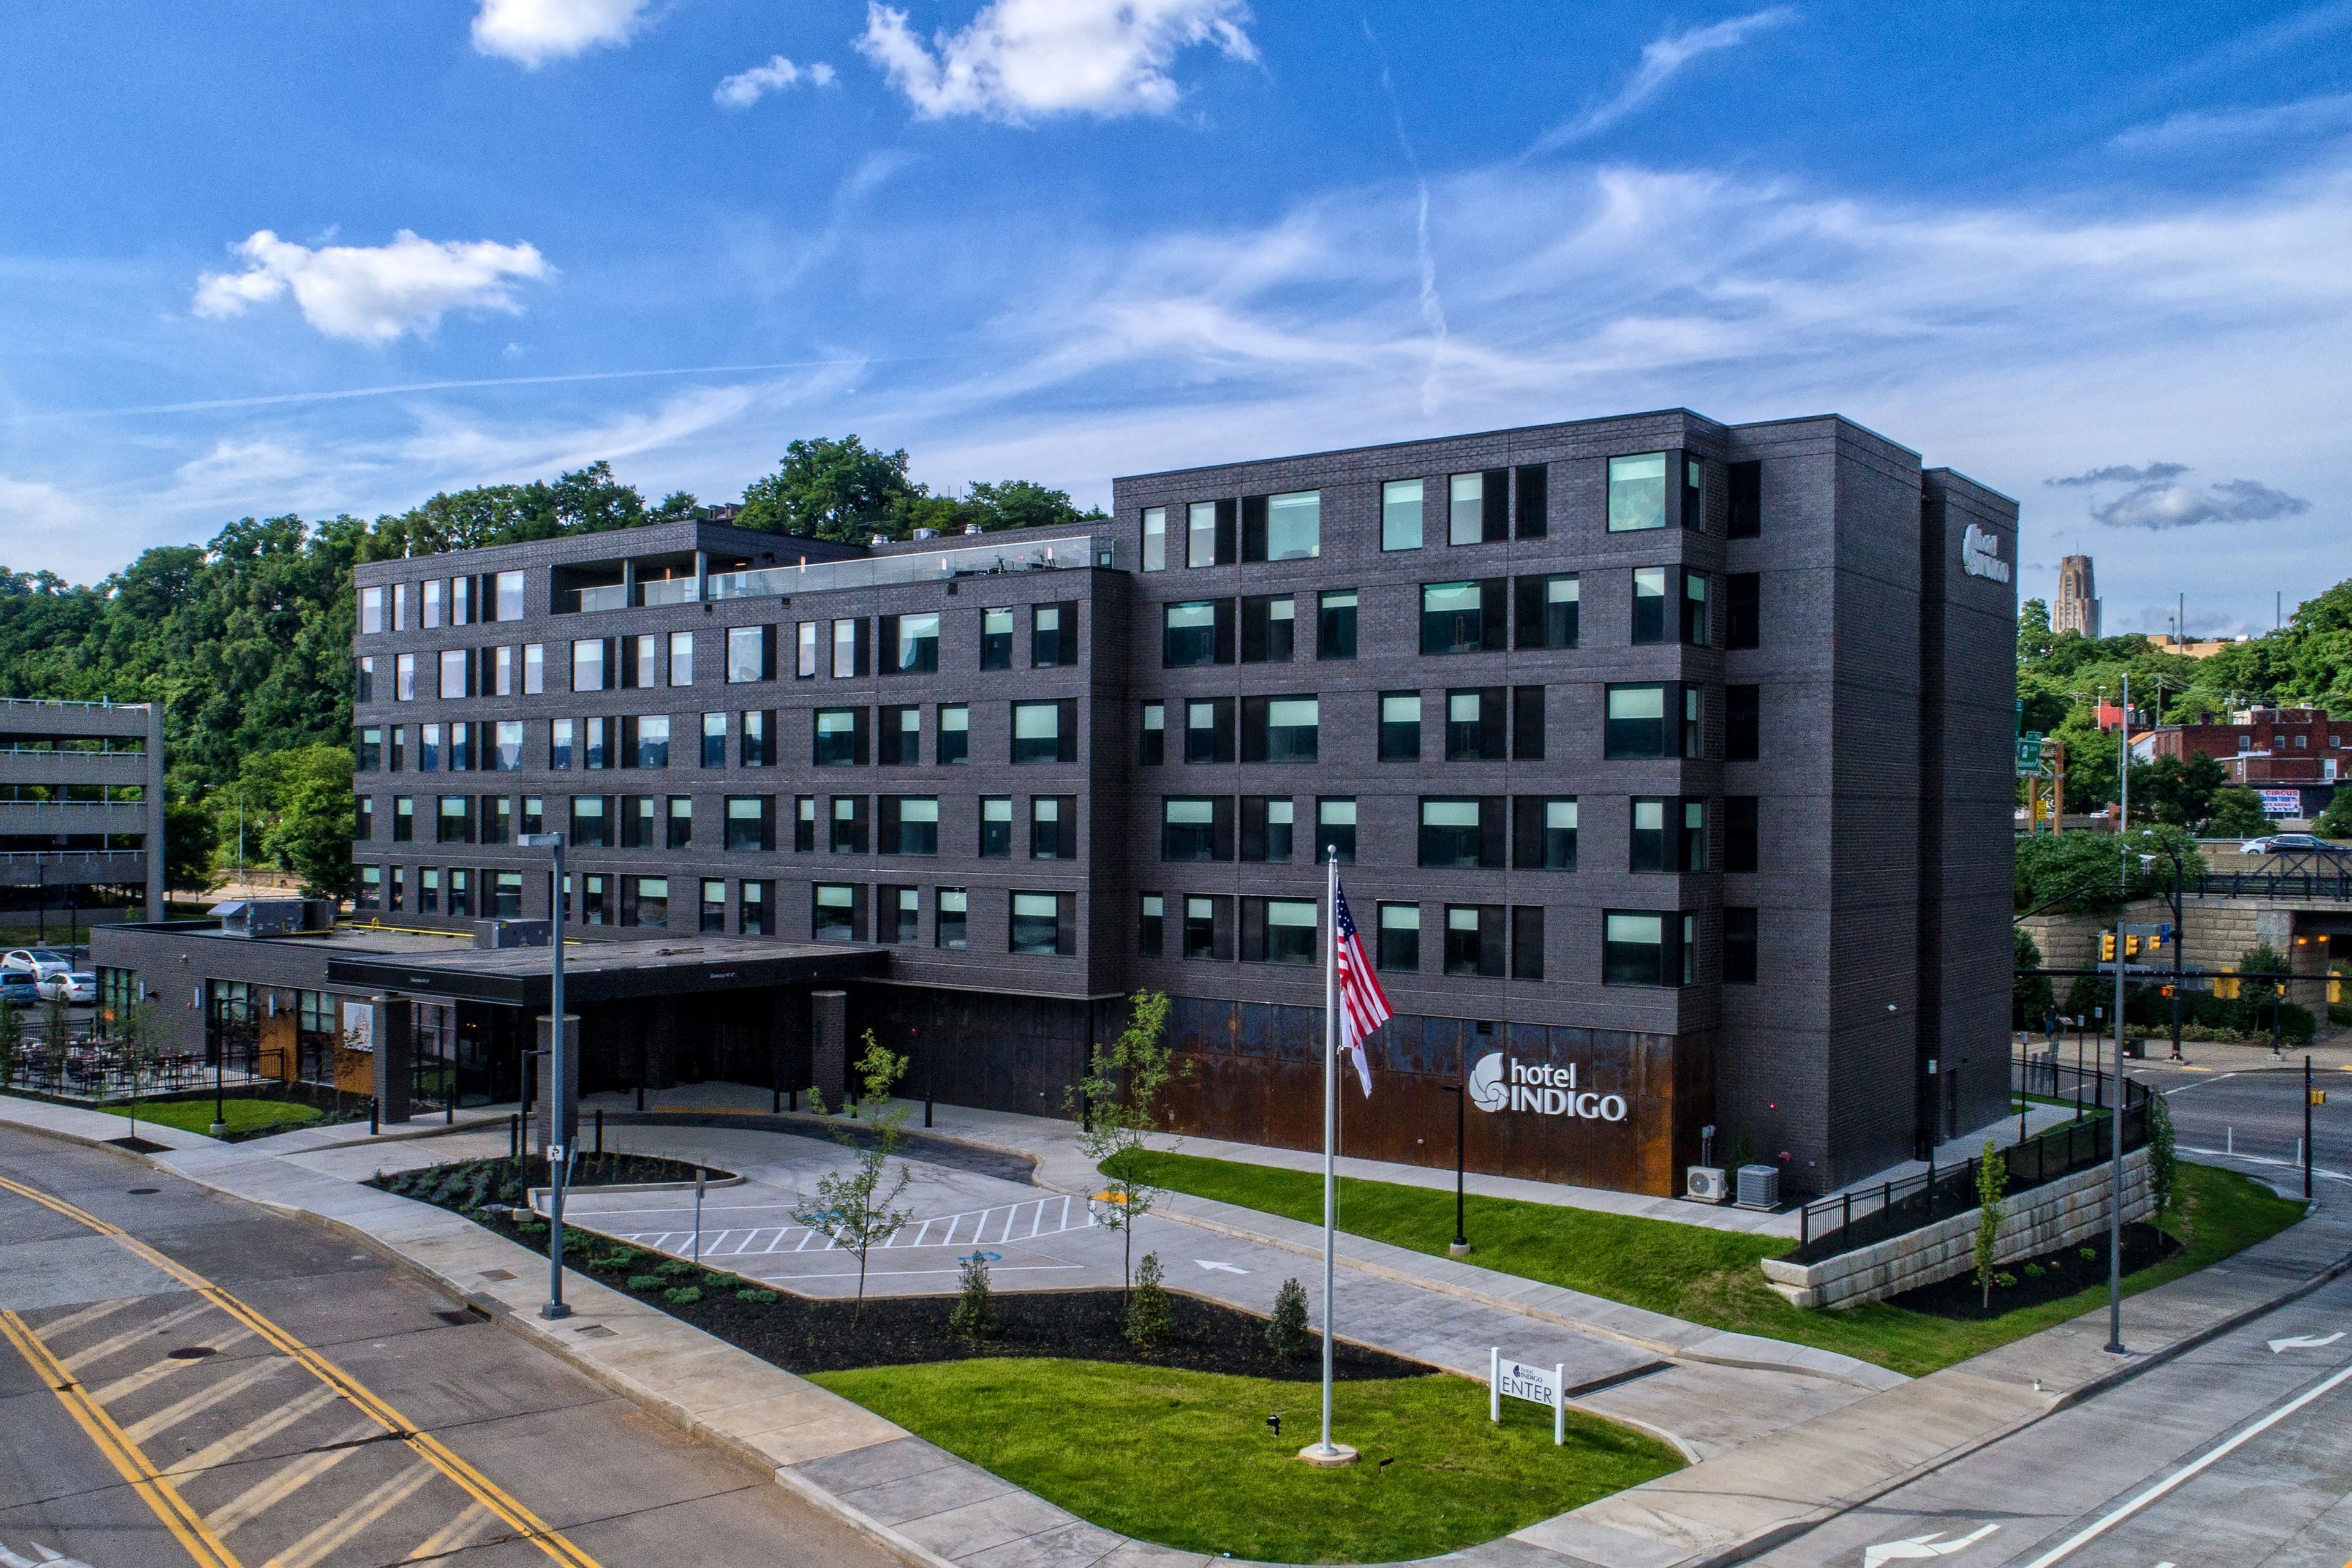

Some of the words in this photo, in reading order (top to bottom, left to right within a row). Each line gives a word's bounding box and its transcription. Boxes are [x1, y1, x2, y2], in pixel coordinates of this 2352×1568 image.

[1511, 1058, 1577, 1088] hotel
[1511, 1085, 1627, 1121] INDIGO
[1502, 1376, 1553, 1404] ENTER
[1520, 1373, 1543, 1383] INDIGO
